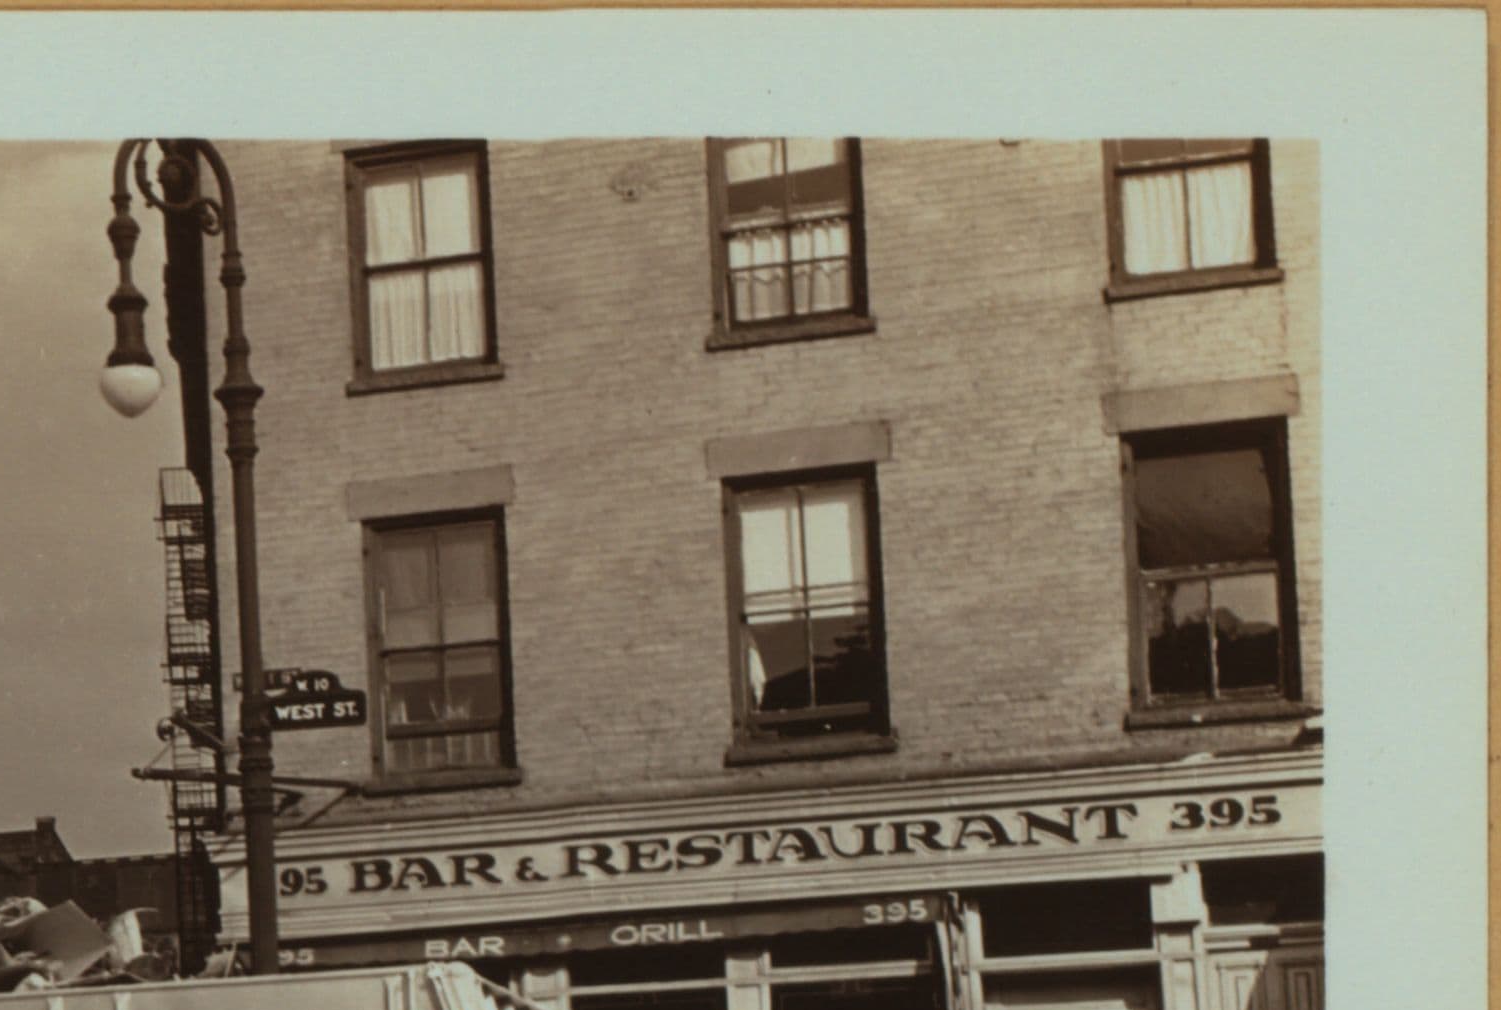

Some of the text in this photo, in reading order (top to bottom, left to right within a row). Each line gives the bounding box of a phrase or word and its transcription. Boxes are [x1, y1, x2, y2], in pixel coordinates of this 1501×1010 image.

[314, 678, 329, 691] 10
[275, 701, 359, 720] WEST ST.
[280, 796, 1282, 897] 95 BAR & RESTAURANT 395
[278, 948, 314, 966] 95
[424, 936, 506, 960] BAR
[863, 900, 928, 923] 395
